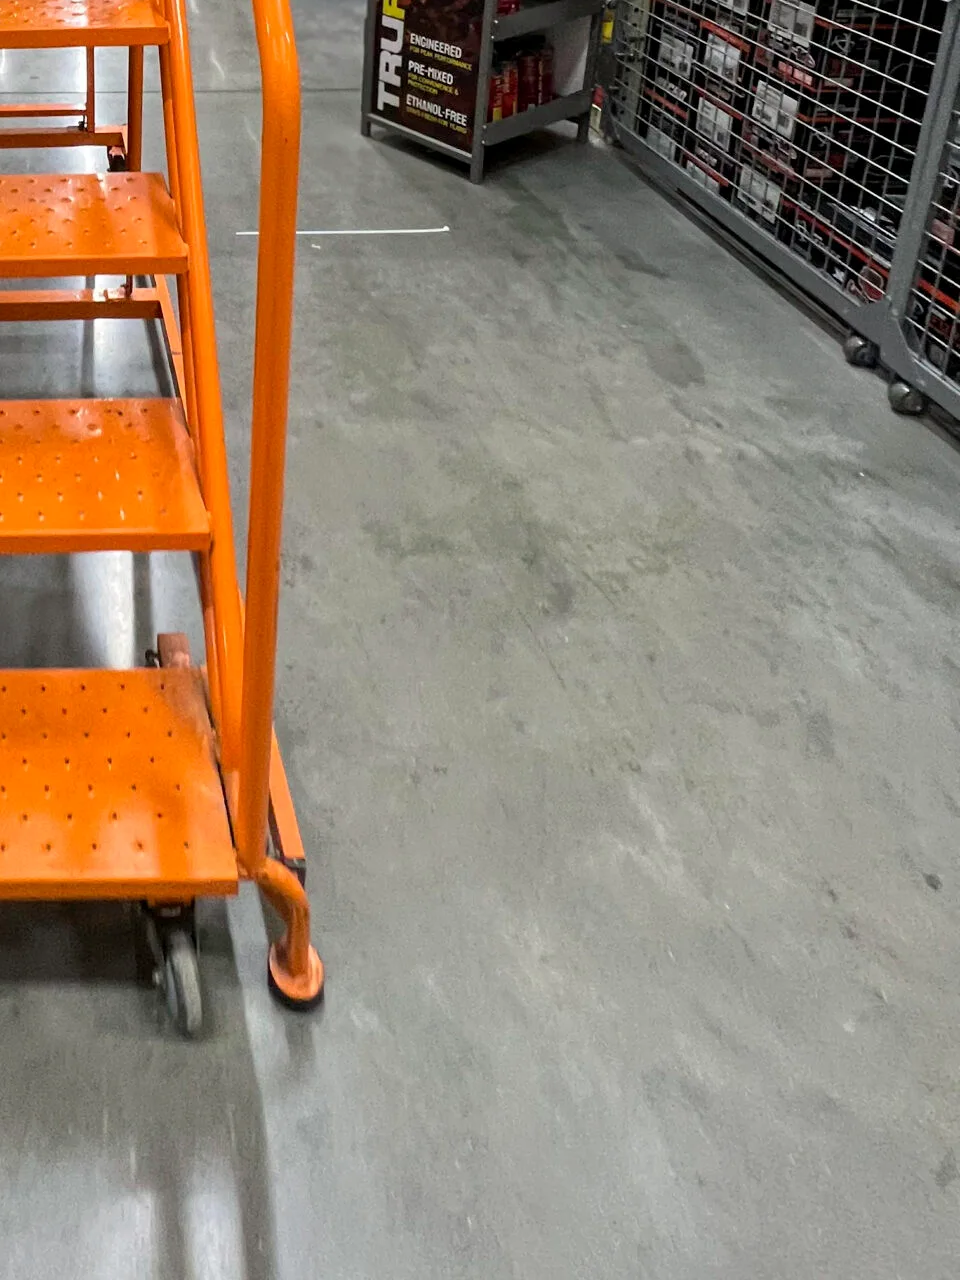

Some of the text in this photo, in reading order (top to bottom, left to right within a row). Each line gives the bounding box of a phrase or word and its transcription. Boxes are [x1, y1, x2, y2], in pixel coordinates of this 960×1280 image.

[410, 33, 463, 59] ENGINEERED
[408, 60, 454, 85] PRE-MIXED
[406, 93, 468, 127] ETHANOL-FREE
